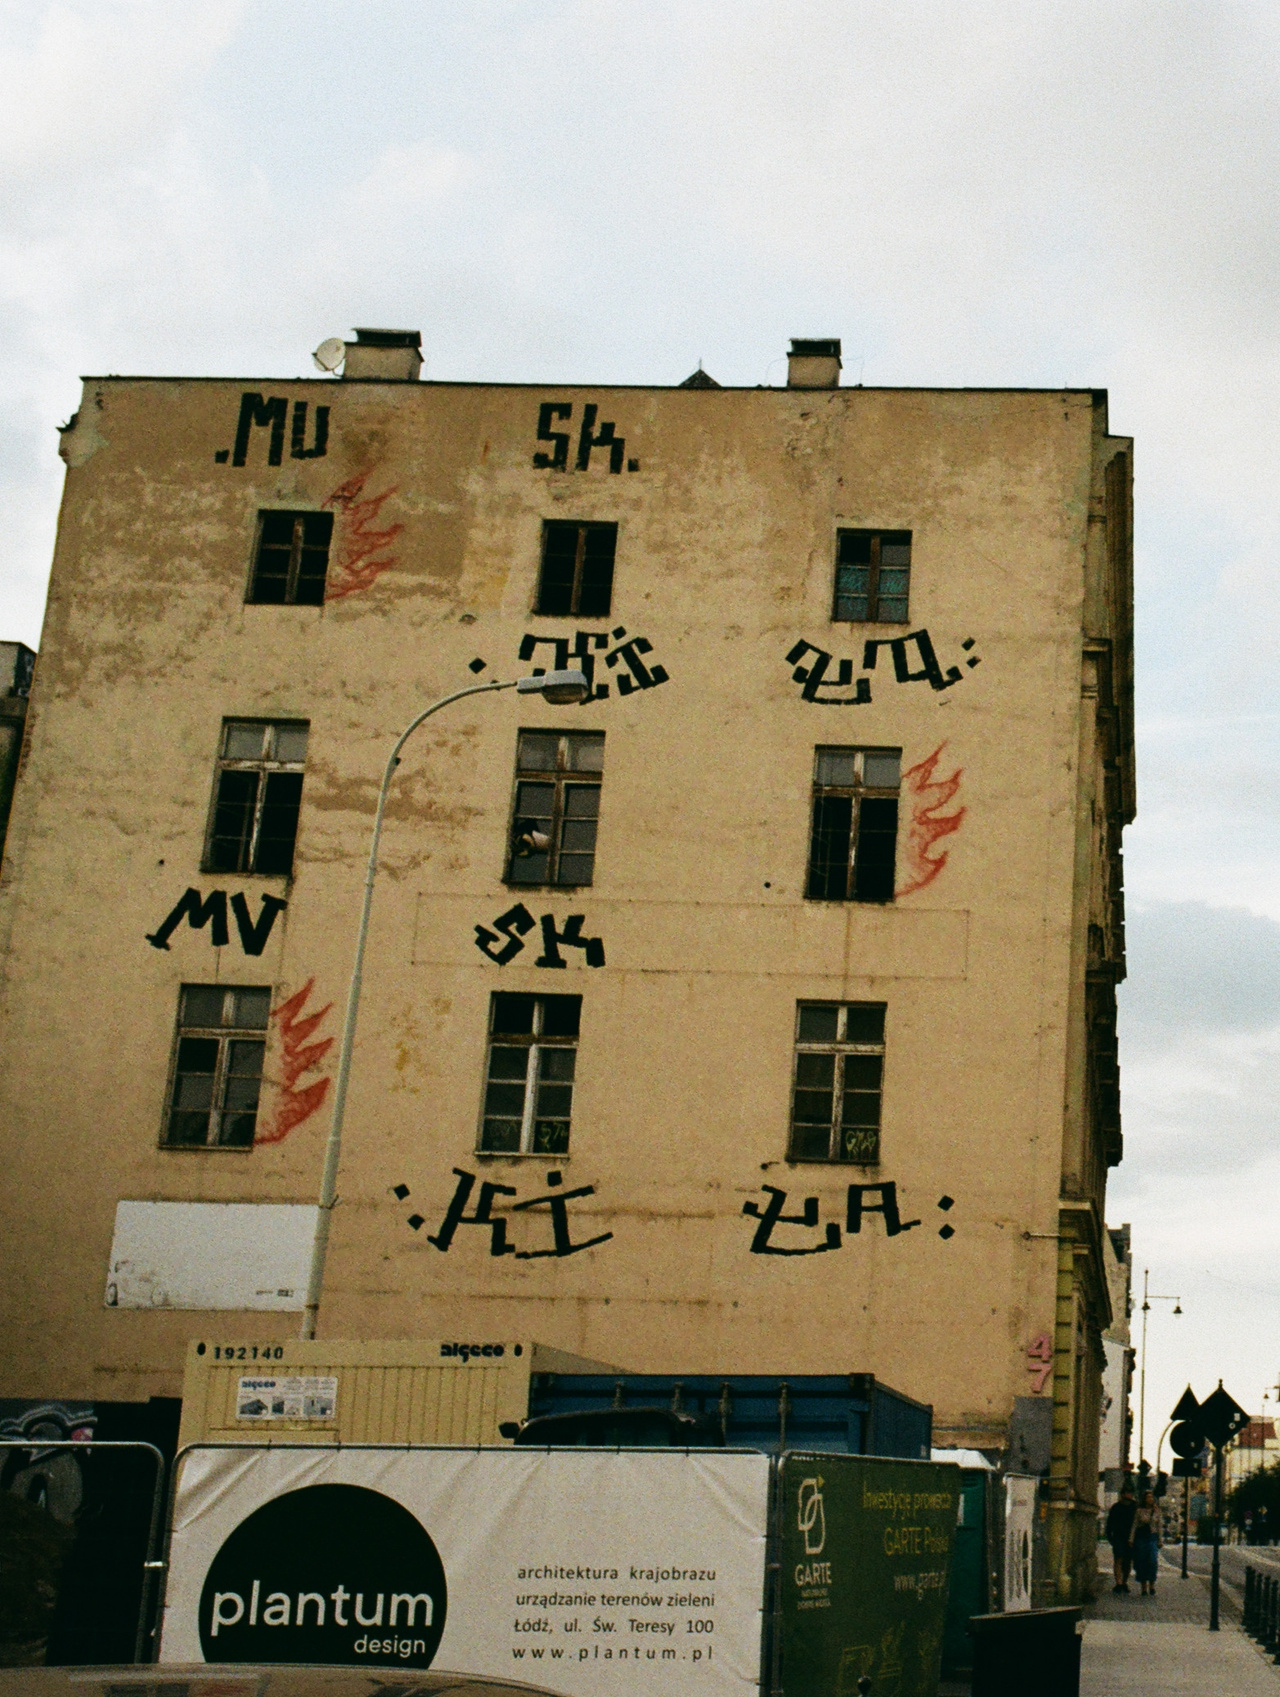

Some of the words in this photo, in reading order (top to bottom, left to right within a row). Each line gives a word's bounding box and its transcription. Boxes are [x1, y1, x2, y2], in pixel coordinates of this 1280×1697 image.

[213, 1345, 285, 1361] 192140
[517, 1565, 619, 1580] architektura
[629, 1565, 716, 1584] krajobrazu
[794, 1561, 833, 1586] GARTE
[210, 1579, 434, 1637] plantum
[515, 1591, 597, 1609] urządzanie
[600, 1591, 664, 1607] terenów
[666, 1592, 716, 1608] zieleni
[513, 1618, 554, 1634] Łódź,
[564, 1618, 583, 1633] ul.
[592, 1616, 618, 1633] Św.
[628, 1618, 676, 1636] Teresy
[686, 1619, 715, 1634] 100
[353, 1634, 427, 1658] design
[511, 1645, 714, 1663] www.plantum.pl
